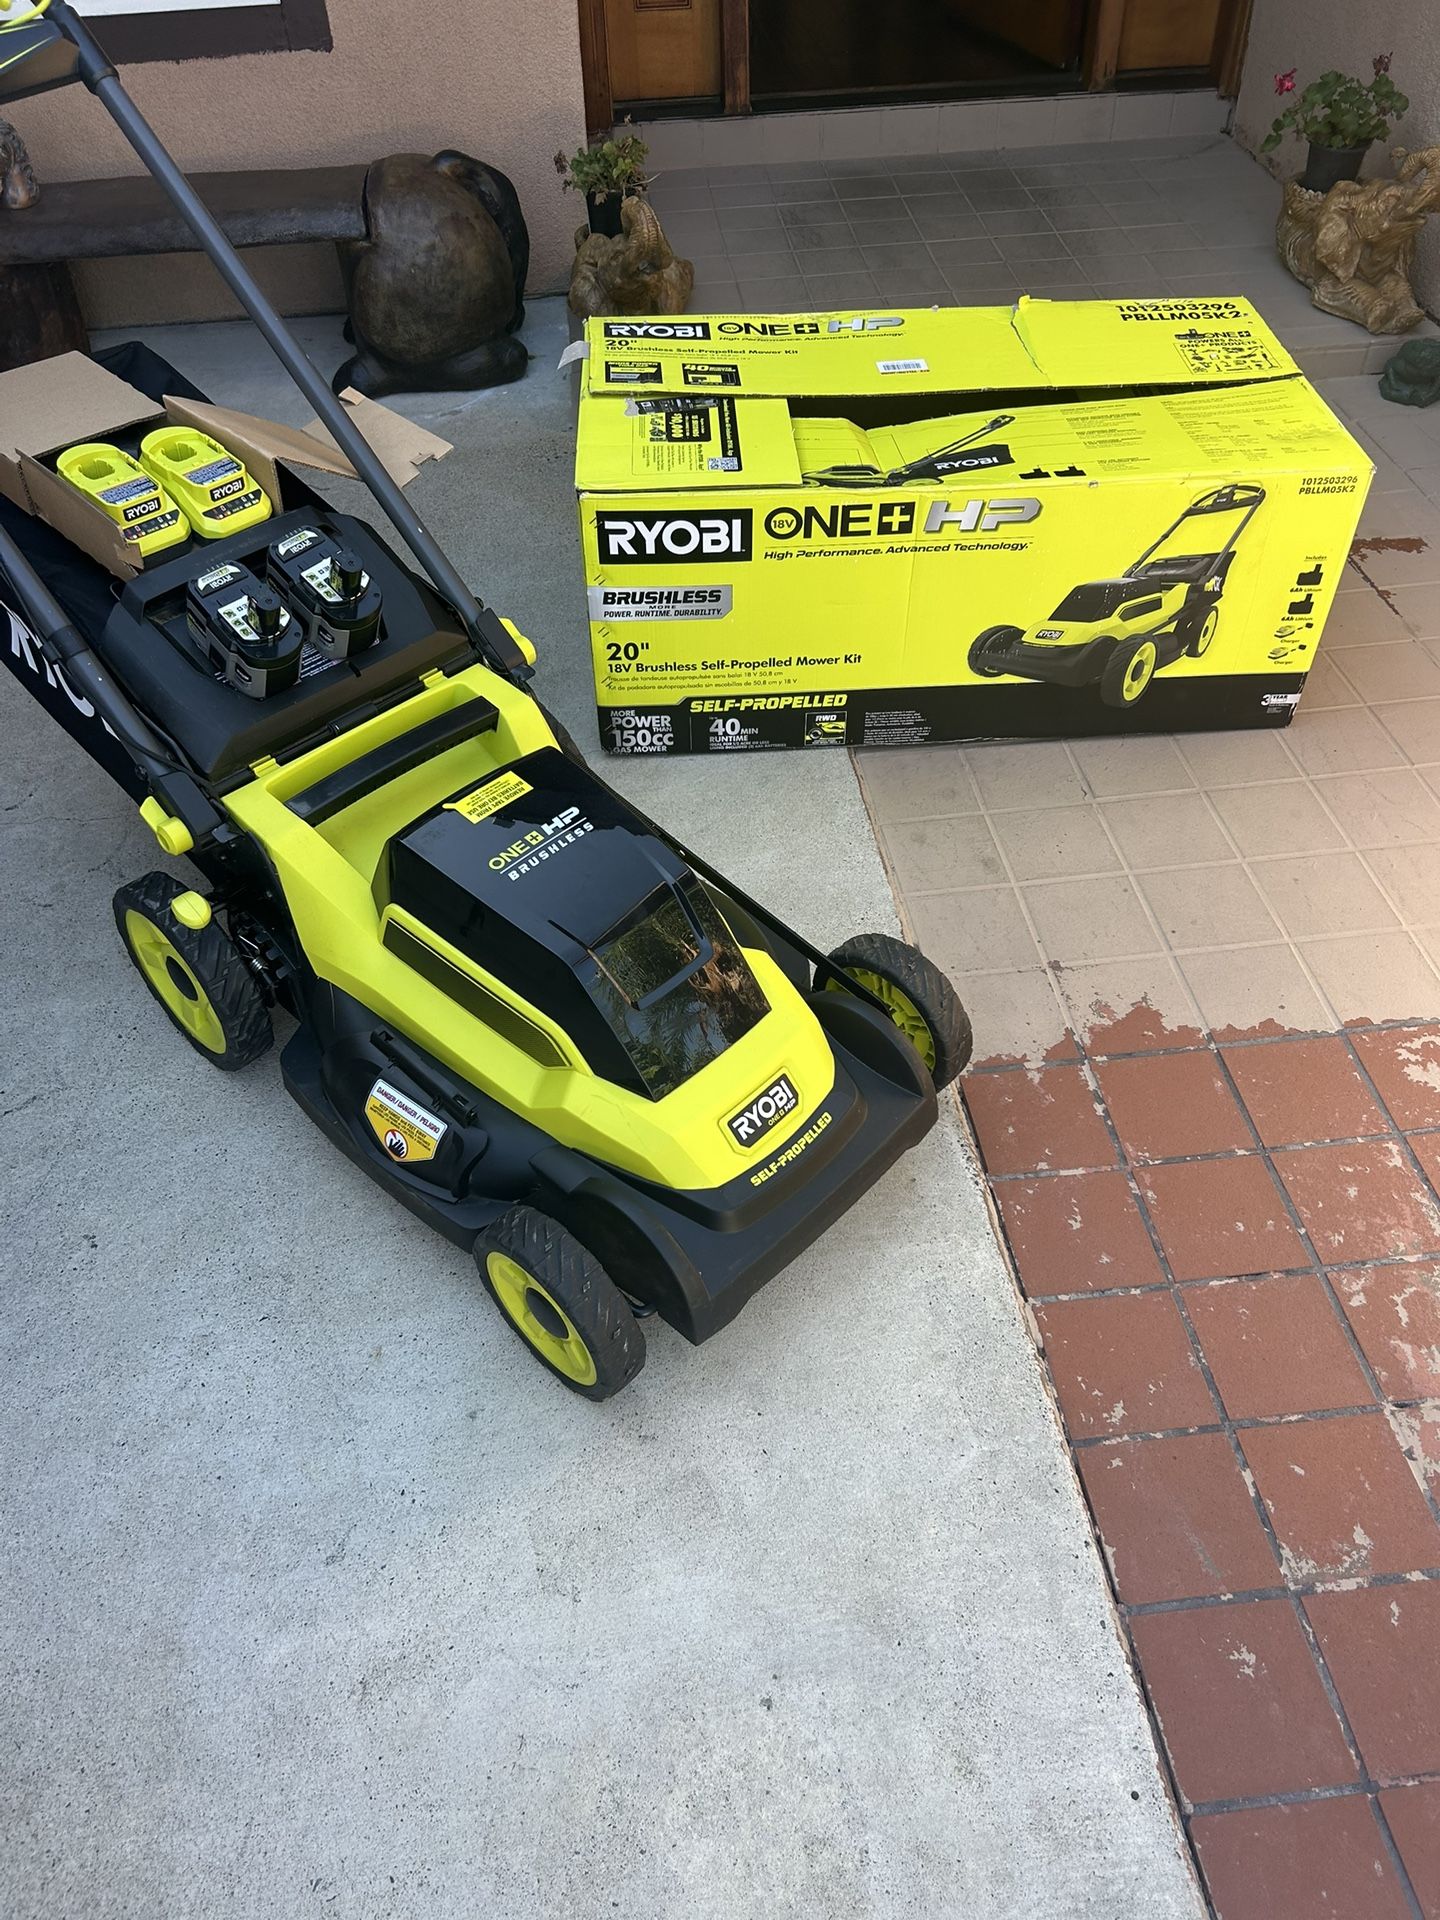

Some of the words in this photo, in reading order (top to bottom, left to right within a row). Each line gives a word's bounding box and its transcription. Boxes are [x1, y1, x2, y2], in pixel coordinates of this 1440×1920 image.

[1115, 302, 1237, 313] 1012503296
[1120, 310, 1242, 322] PBLLM05K2
[609, 324, 704, 338] RYOBI
[827, 317, 905, 333] HP
[605, 339, 638, 347] 20"
[676, 348, 746, 356] Self-Propelled
[934, 456, 999, 471] RYOBI
[1302, 476, 1358, 486] 1012503296
[212, 480, 243, 500] RYOBI
[1298, 485, 1356, 495] PBLLM05K2
[125, 499, 159, 520] RYOBI
[772, 519, 795, 530] 18V
[923, 497, 1044, 534] HP
[604, 518, 742, 555] RYOBI
[290, 539, 313, 554] RYOBI
[764, 551, 794, 560] High
[796, 548, 884, 559] Performance.
[885, 544, 951, 554] Advanced
[953, 541, 1030, 553] Technology.
[209, 574, 234, 589] RYOBI
[602, 589, 722, 605] BRUSHLESS
[603, 610, 633, 618] POWER.
[634, 609, 672, 618] RUNTIME.
[673, 608, 723, 617] DURABILITY.
[606, 642, 650, 661] 20"
[608, 663, 632, 673] 18V
[635, 661, 698, 673] Brushless
[701, 657, 792, 671] Self-Propelled
[796, 656, 841, 666] Mower
[843, 654, 862, 664] Kit
[714, 680, 743, 688] escobillas
[689, 694, 848, 713] SELF-PROPELLED
[1260, 694, 1271, 706] 3
[611, 715, 672, 728] POWER
[815, 714, 837, 722] RWD
[709, 718, 741, 736] 40
[611, 729, 674, 747] 150cc
[709, 735, 749, 743] RUNTIME
[612, 746, 632, 754] GAS
[540, 806, 580, 836] HP
[507, 821, 594, 881] BRUSHLESS
[731, 1079, 794, 1140] RYOBI
[784, 1098, 796, 1112] HP
[420, 1116, 441, 1134] PELIGRO
[750, 1111, 833, 1187] SELF-PROPELLED
